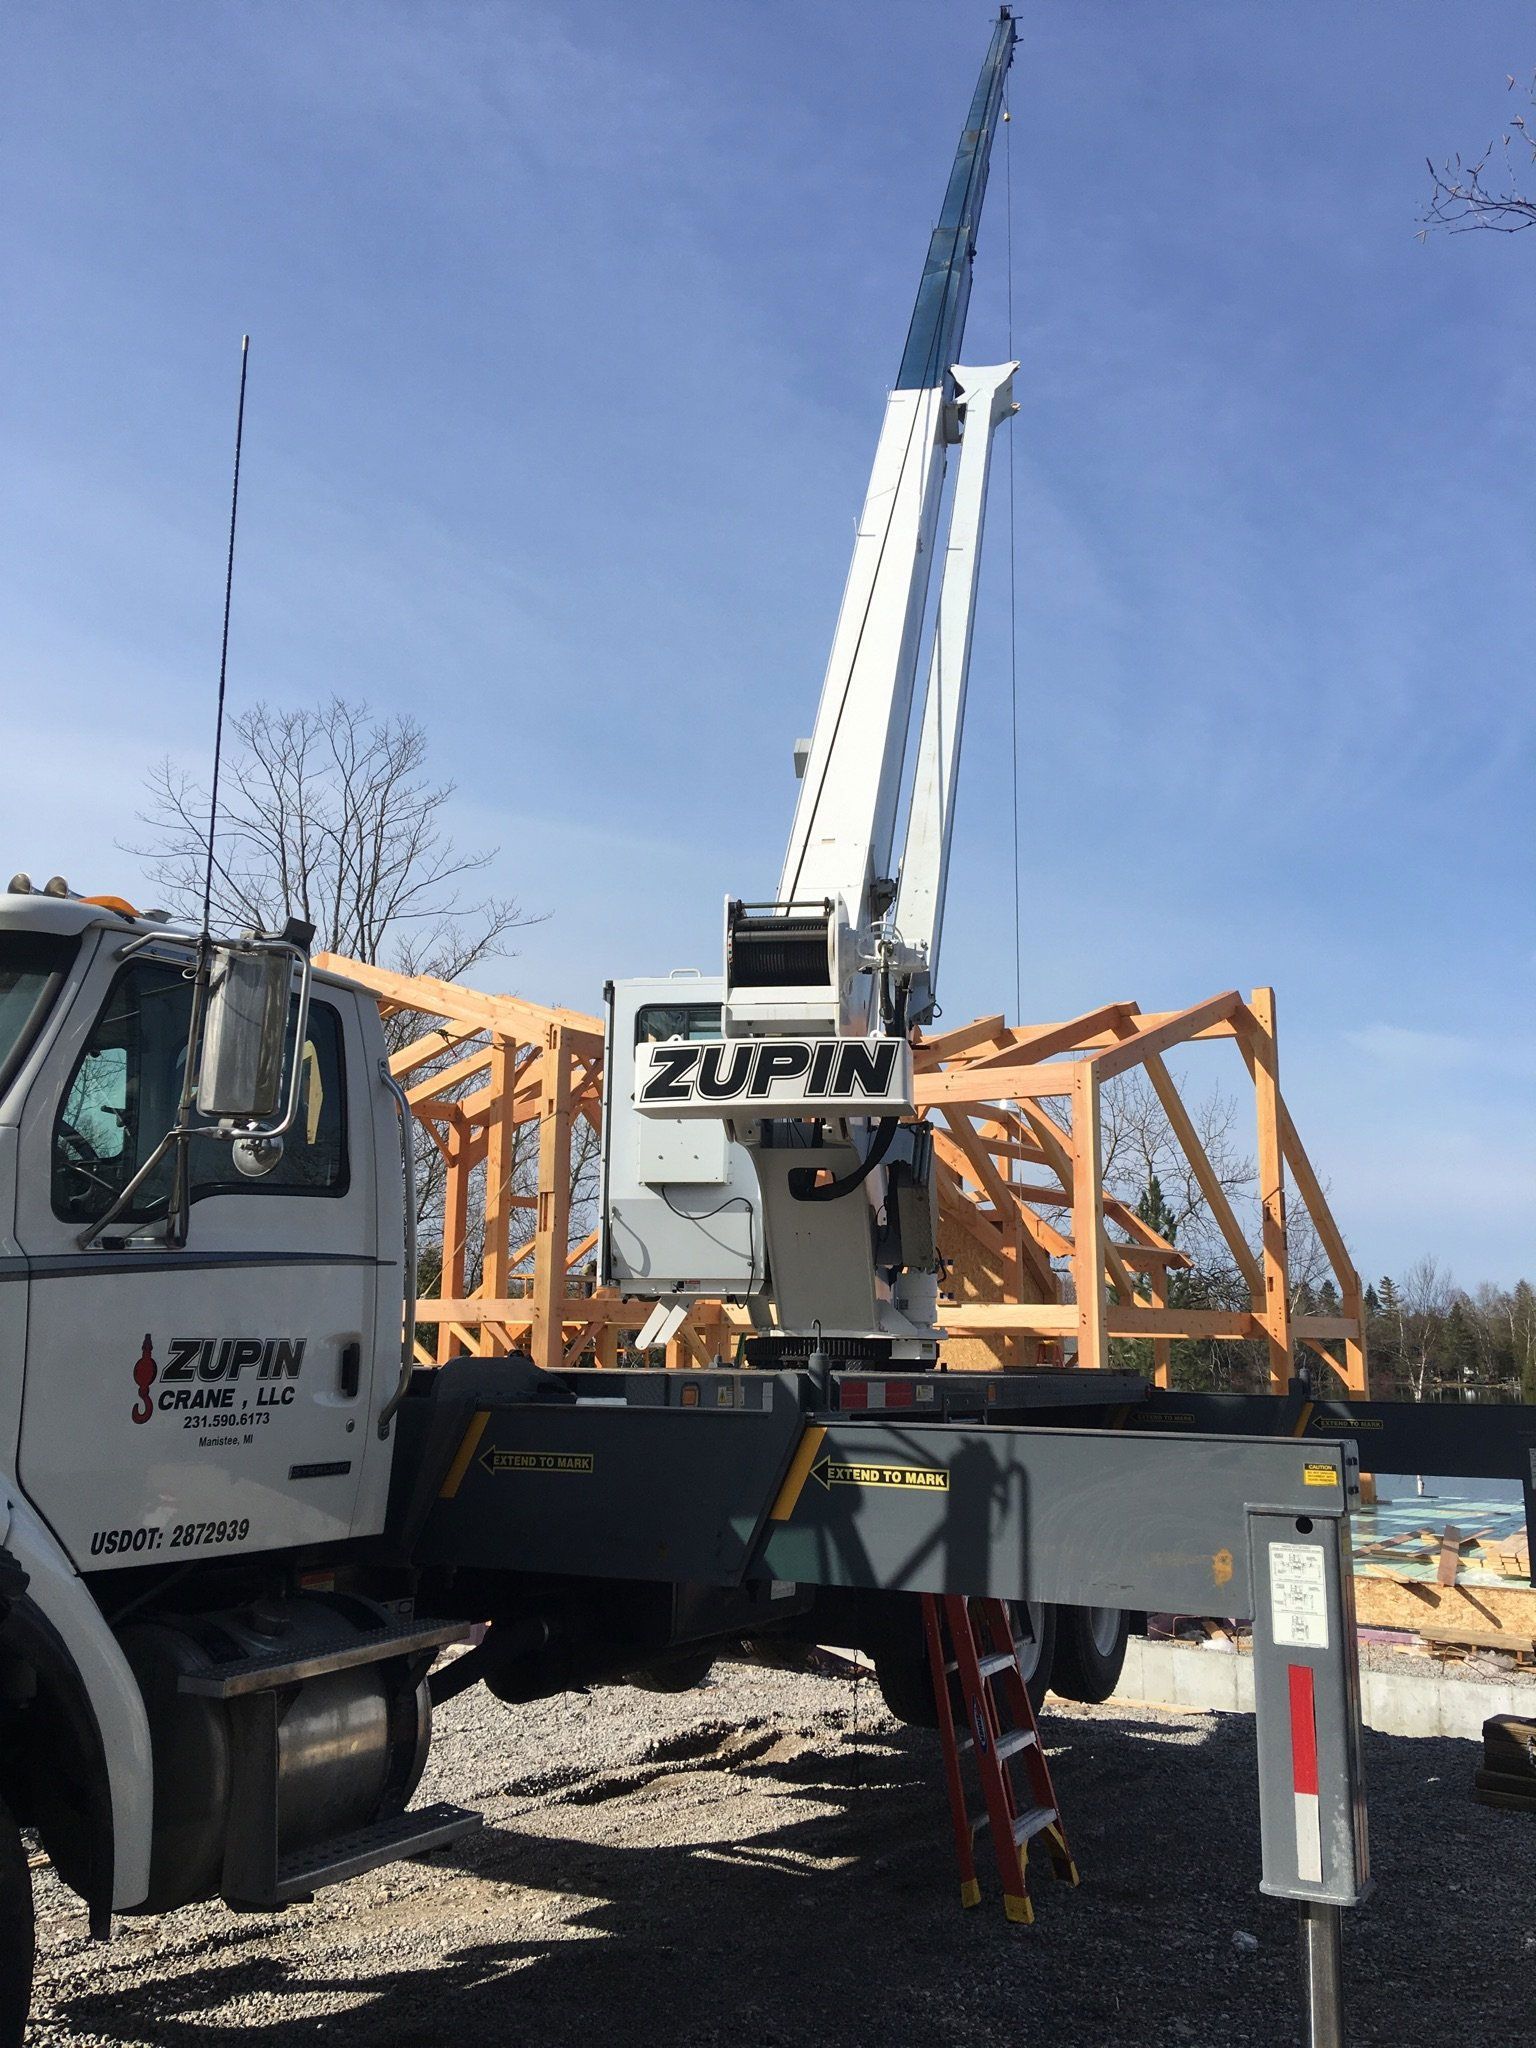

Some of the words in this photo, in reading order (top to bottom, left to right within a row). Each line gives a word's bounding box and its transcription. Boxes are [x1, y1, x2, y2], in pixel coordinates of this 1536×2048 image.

[640, 1041, 899, 1103] ZUPIN
[159, 1338, 307, 1382] ZUPIN
[256, 1386, 295, 1406] LLC
[183, 1412, 270, 1429] 231.590.6173
[199, 1435, 240, 1447] Manistee,
[243, 1434, 253, 1444] MI
[493, 1455, 537, 1466] EXTEND
[540, 1456, 554, 1467] TO
[558, 1457, 589, 1468] MARK
[828, 1467, 880, 1482] EXTEND
[883, 1470, 902, 1483] TO
[905, 1472, 945, 1486] MARK
[90, 1527, 164, 1555] USDOT:
[170, 1518, 250, 1547] 2872939
